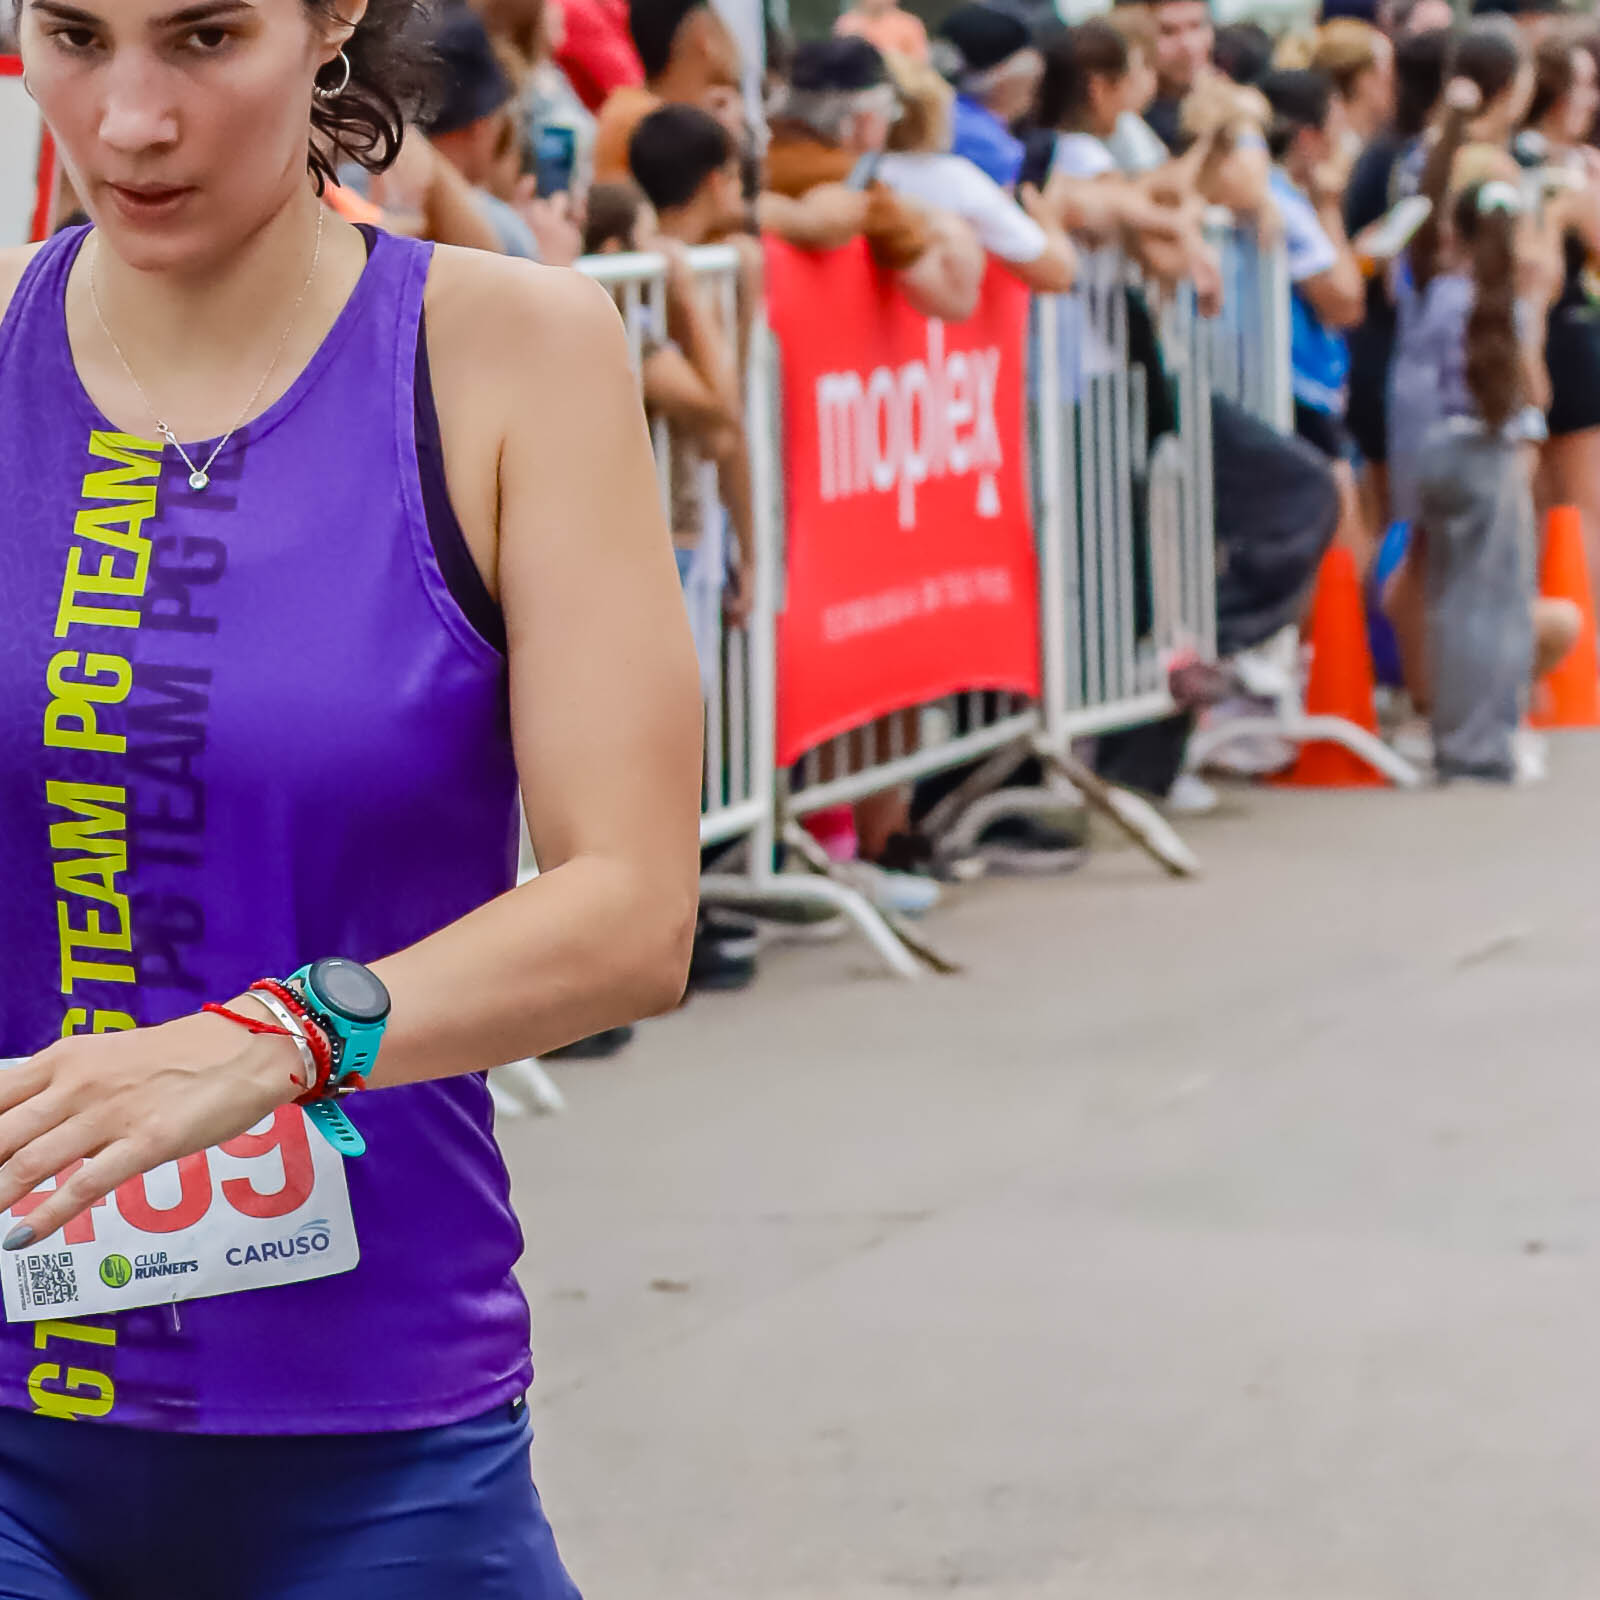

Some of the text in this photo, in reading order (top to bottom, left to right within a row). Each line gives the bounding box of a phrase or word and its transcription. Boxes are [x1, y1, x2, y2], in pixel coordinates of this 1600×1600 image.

[815, 316, 1002, 530] moplex
[54, 430, 164, 638] TEAM
[43, 650, 133, 753] PG
[46, 780, 136, 995] TEAM
[135, 1252, 167, 1266] CLUB
[226, 1233, 330, 1266] CARUSO
[28, 1363, 115, 1421] G
